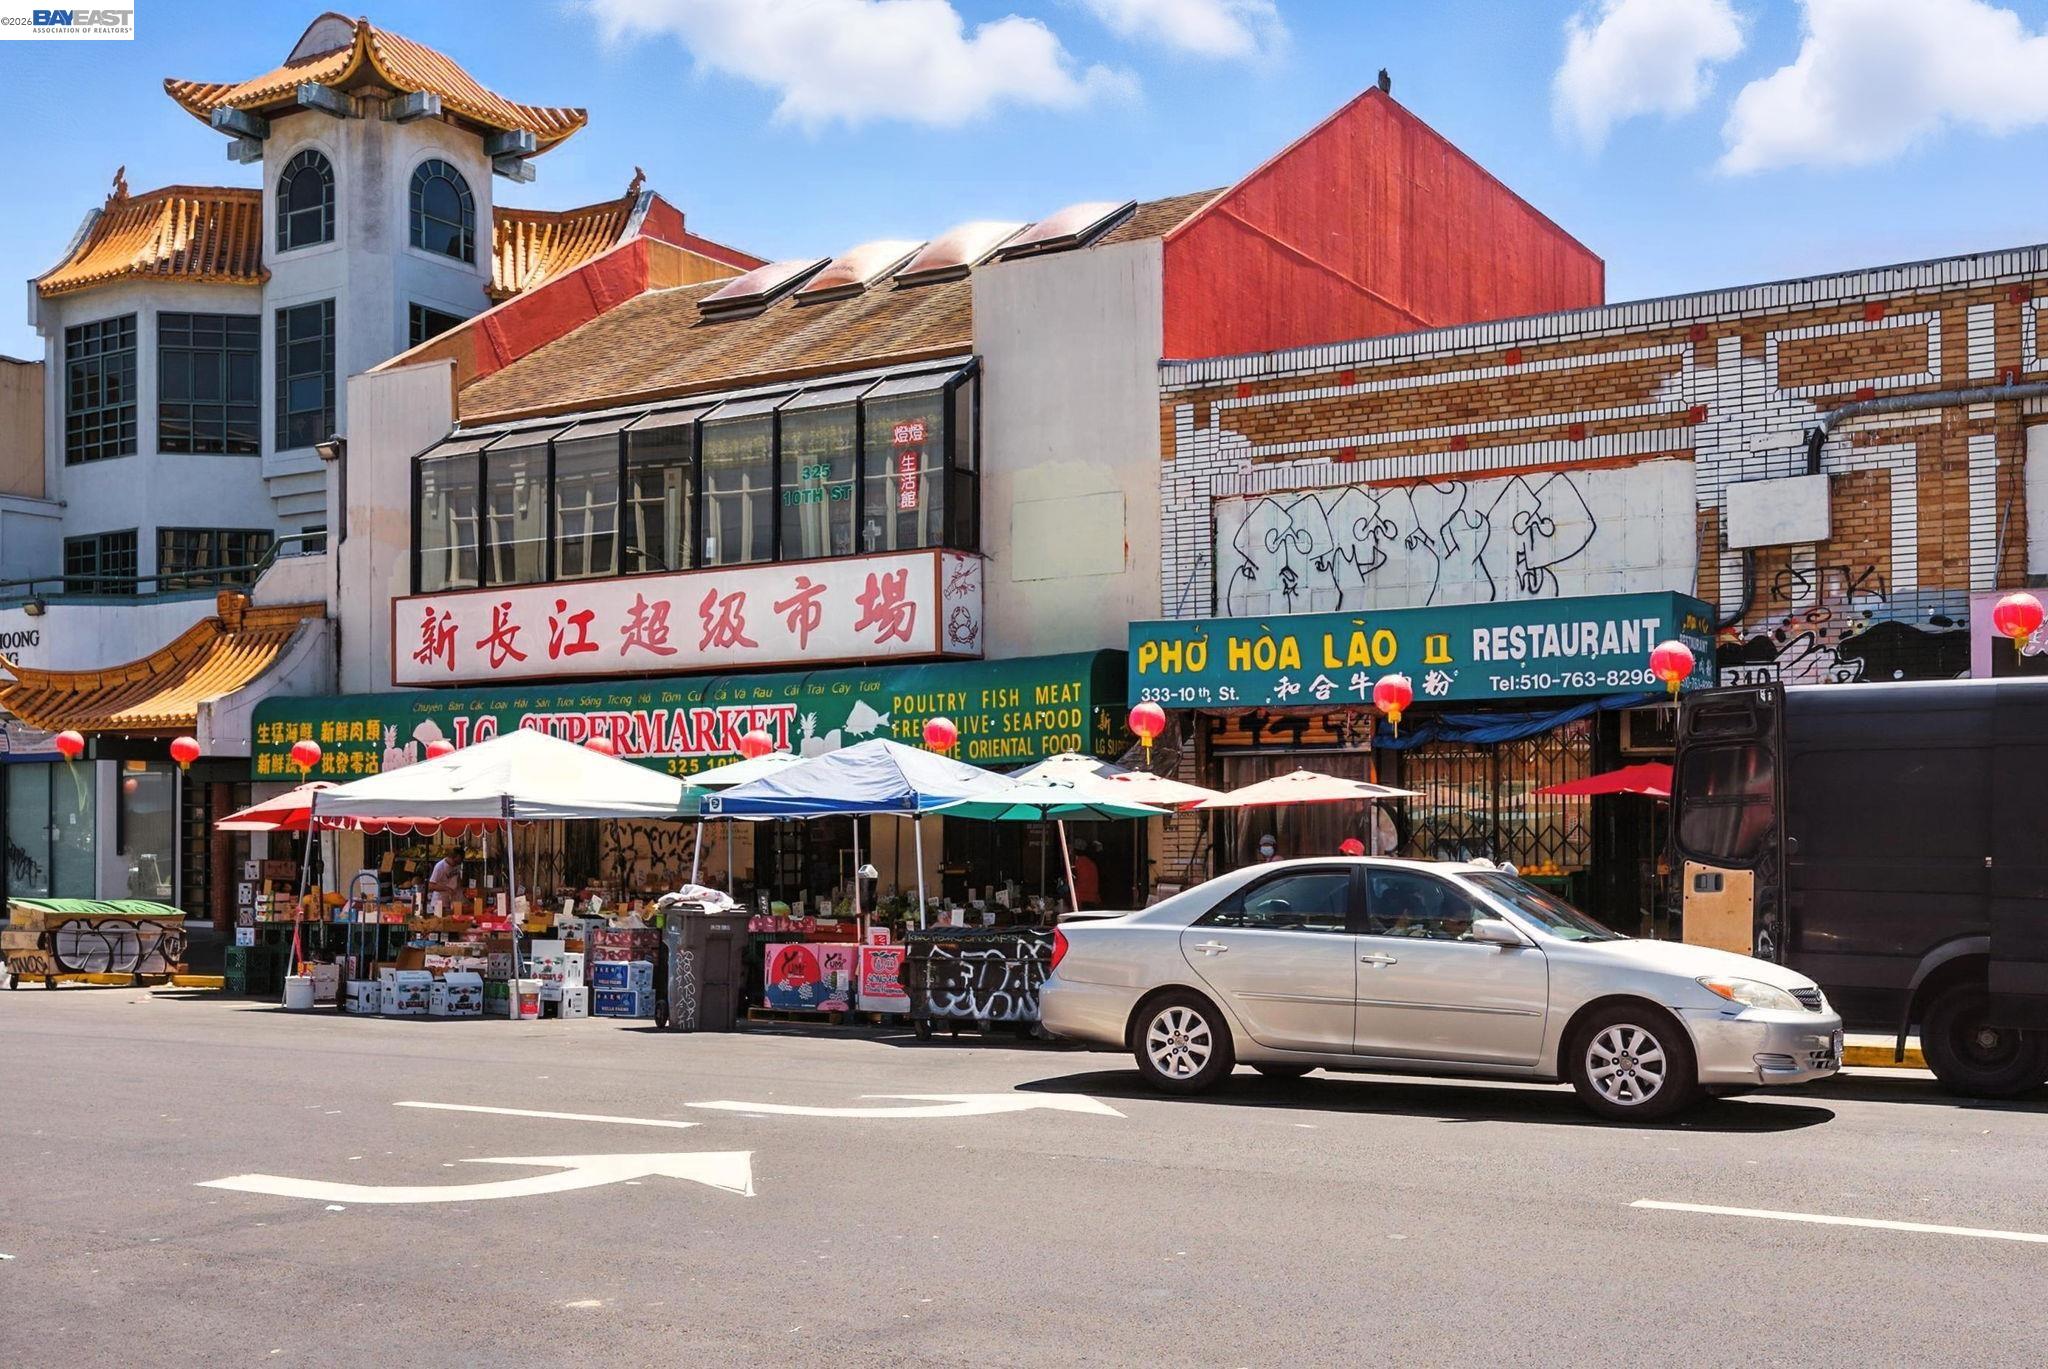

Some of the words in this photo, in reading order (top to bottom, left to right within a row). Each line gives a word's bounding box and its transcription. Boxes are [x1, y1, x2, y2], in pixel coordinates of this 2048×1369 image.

[802, 465, 831, 480] 325
[900, 455, 917, 508] 生活館
[783, 488, 824, 506] 10TH
[832, 485, 852, 501] ST
[413, 568, 916, 672] 新長江超級市場
[1473, 618, 1660, 661] RESTAURANT
[1274, 671, 1454, 702] 和合牛粉
[1490, 670, 1656, 691] Tel:510-763-8296
[893, 692, 967, 715] POULTRY
[982, 689, 1019, 709] FISH
[1036, 682, 1082, 706] MEAT
[1219, 686, 1240, 701] St.
[320, 719, 380, 743] 新鮮肉類
[1003, 708, 1082, 733] SEAFOOD
[969, 736, 1034, 759] ORIENTAL
[1042, 733, 1082, 755] FOOD
[668, 758, 699, 774] 325
